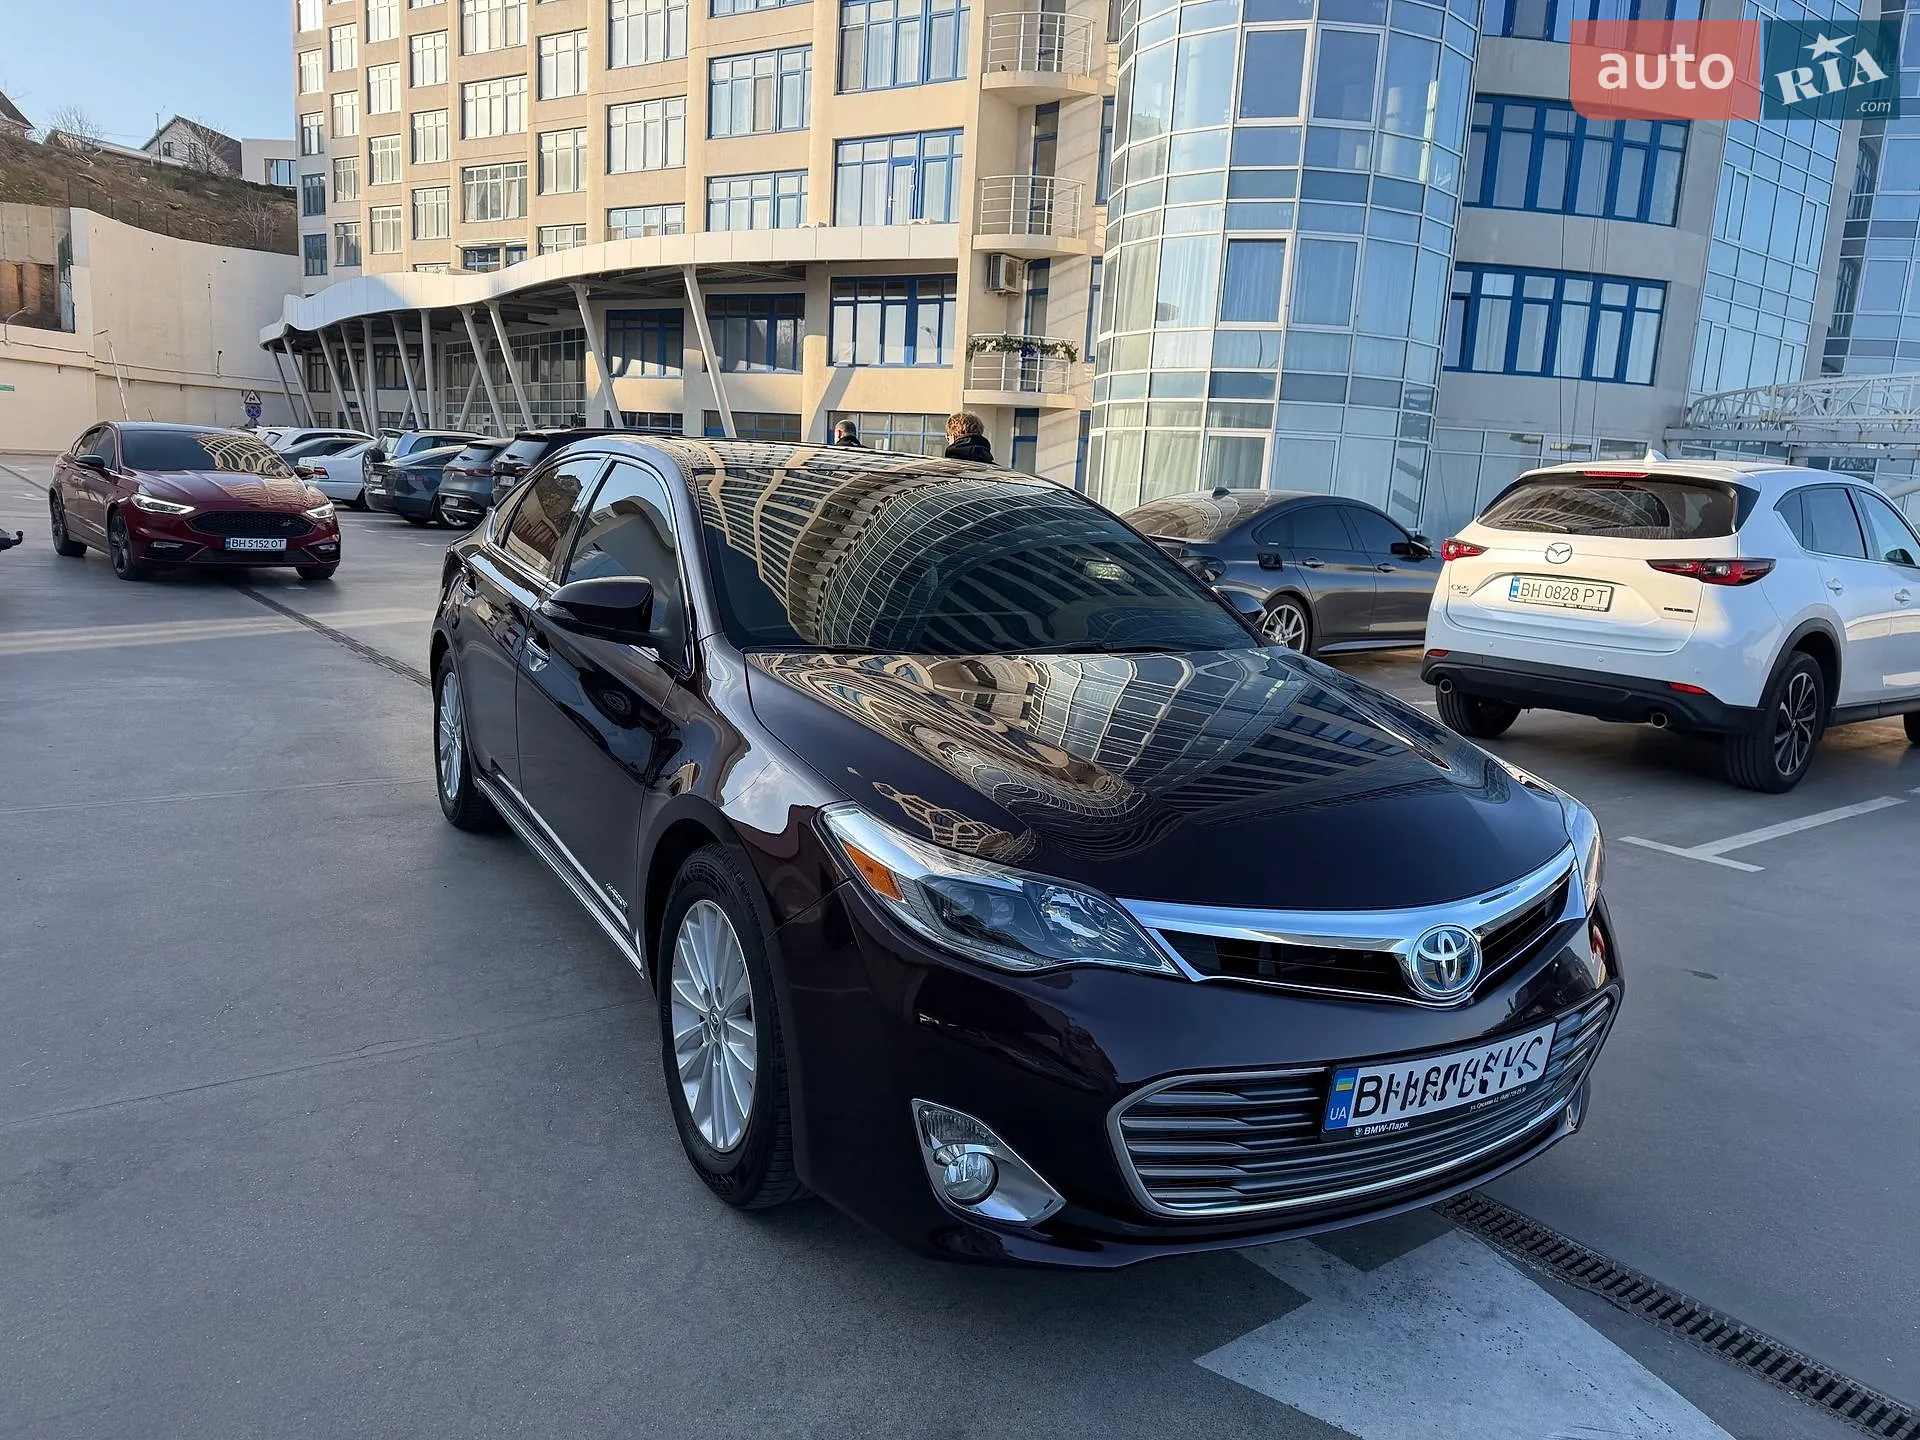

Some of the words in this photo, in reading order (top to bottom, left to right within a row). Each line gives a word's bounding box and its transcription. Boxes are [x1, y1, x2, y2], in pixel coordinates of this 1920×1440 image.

[231, 539, 246, 548] BH
[247, 539, 269, 548] 5152
[270, 539, 285, 548] OT
[1520, 582, 1542, 598] BH
[1544, 584, 1579, 601] 0828
[1582, 588, 1608, 605] PT
[1329, 1105, 1347, 1121] UA
